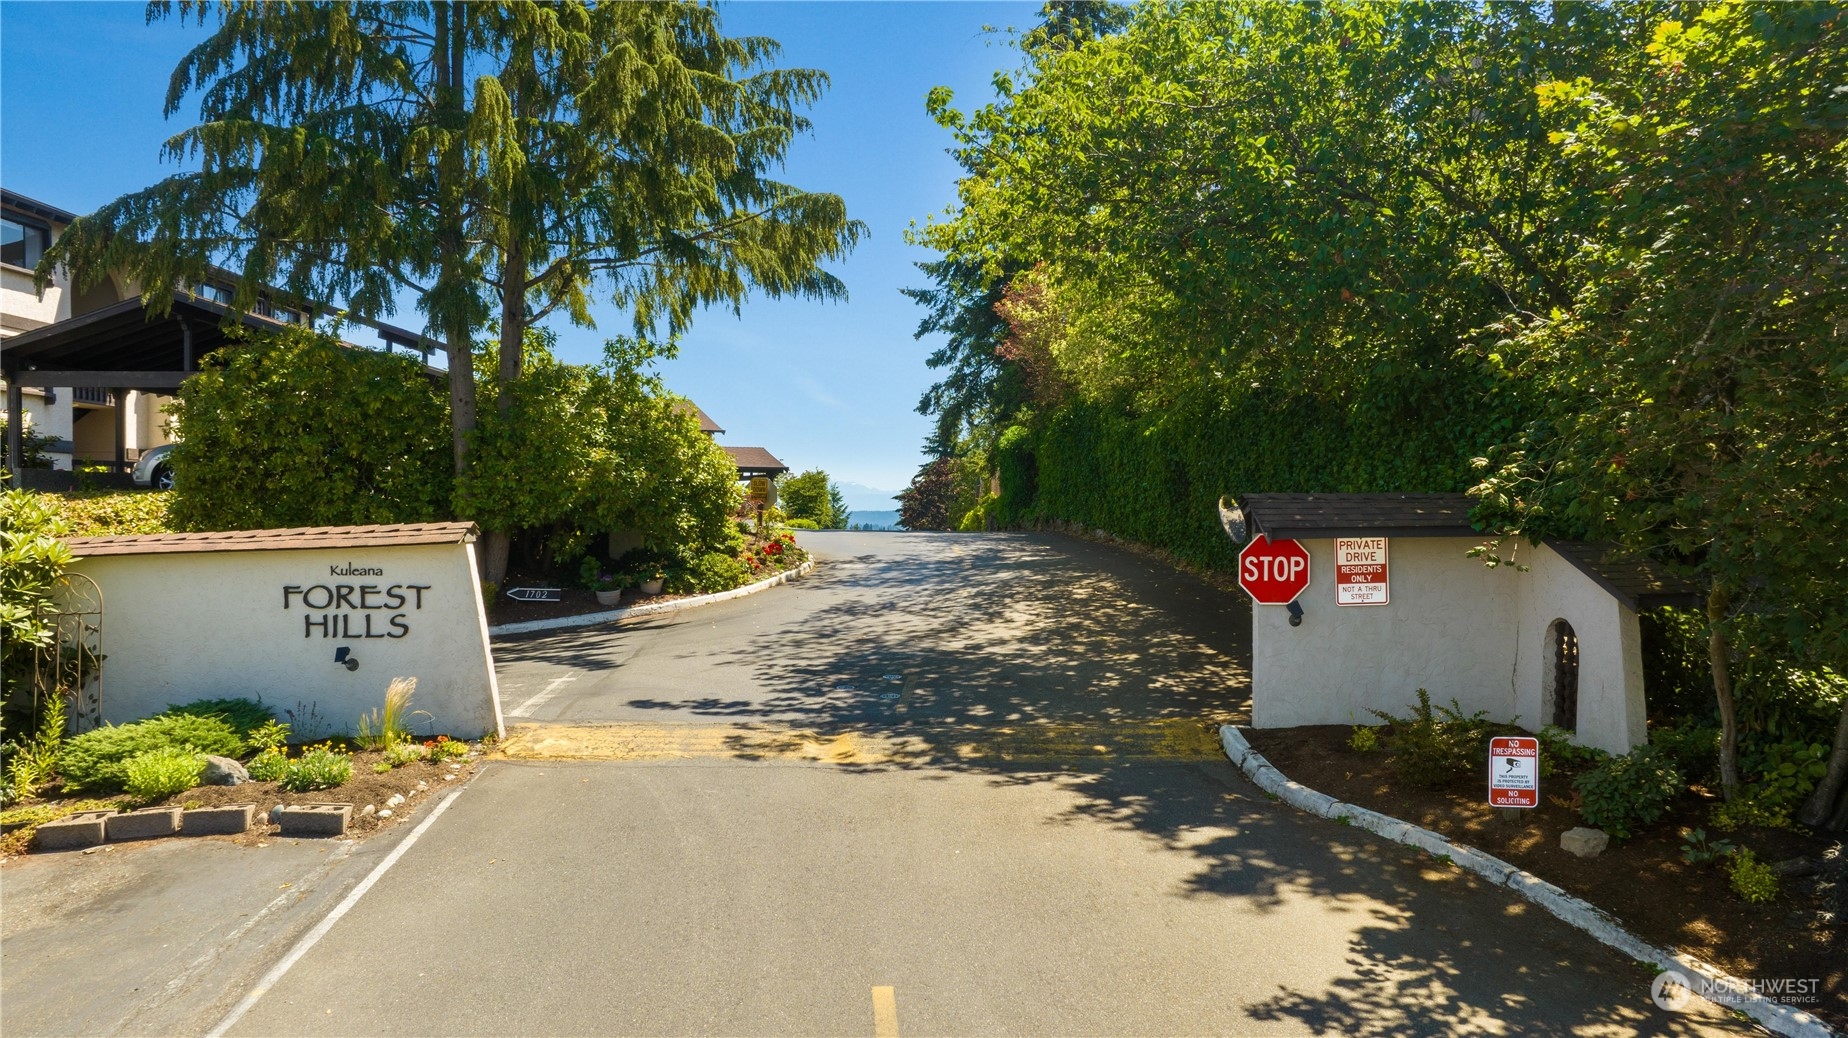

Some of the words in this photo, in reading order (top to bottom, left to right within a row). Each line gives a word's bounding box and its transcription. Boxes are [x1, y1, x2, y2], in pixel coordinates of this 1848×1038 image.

[1339, 540, 1383, 550] PRIVATE
[1345, 552, 1377, 562] DRIVE
[330, 562, 383, 576] Kuleana
[1244, 556, 1305, 582] STOP
[1341, 565, 1382, 574] RESIDENTS
[1351, 574, 1373, 583] ONLY
[283, 585, 431, 609] FOREST
[525, 590, 548, 599] 1702
[304, 613, 410, 638] HILLS
[1508, 740, 1520, 748] NO
[1492, 748, 1536, 756] TRESPASSING
[1496, 797, 1531, 805] SOLICITING
